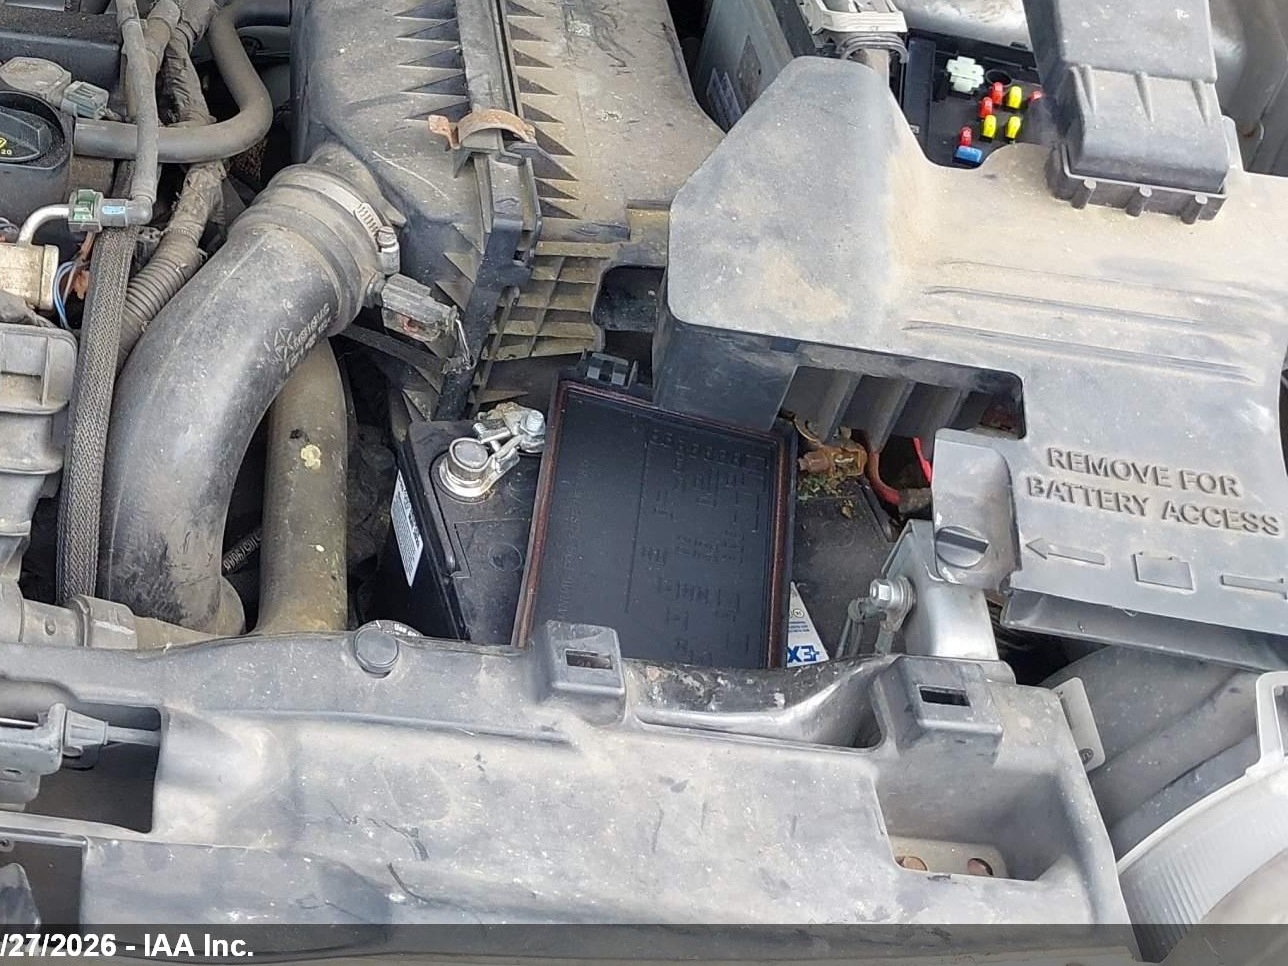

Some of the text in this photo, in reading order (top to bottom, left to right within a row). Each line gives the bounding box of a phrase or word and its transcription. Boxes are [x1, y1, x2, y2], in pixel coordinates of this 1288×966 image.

[1047, 447, 1240, 497] REMOVE FOR
[1027, 476, 1281, 536] BATTERY ACCESS
